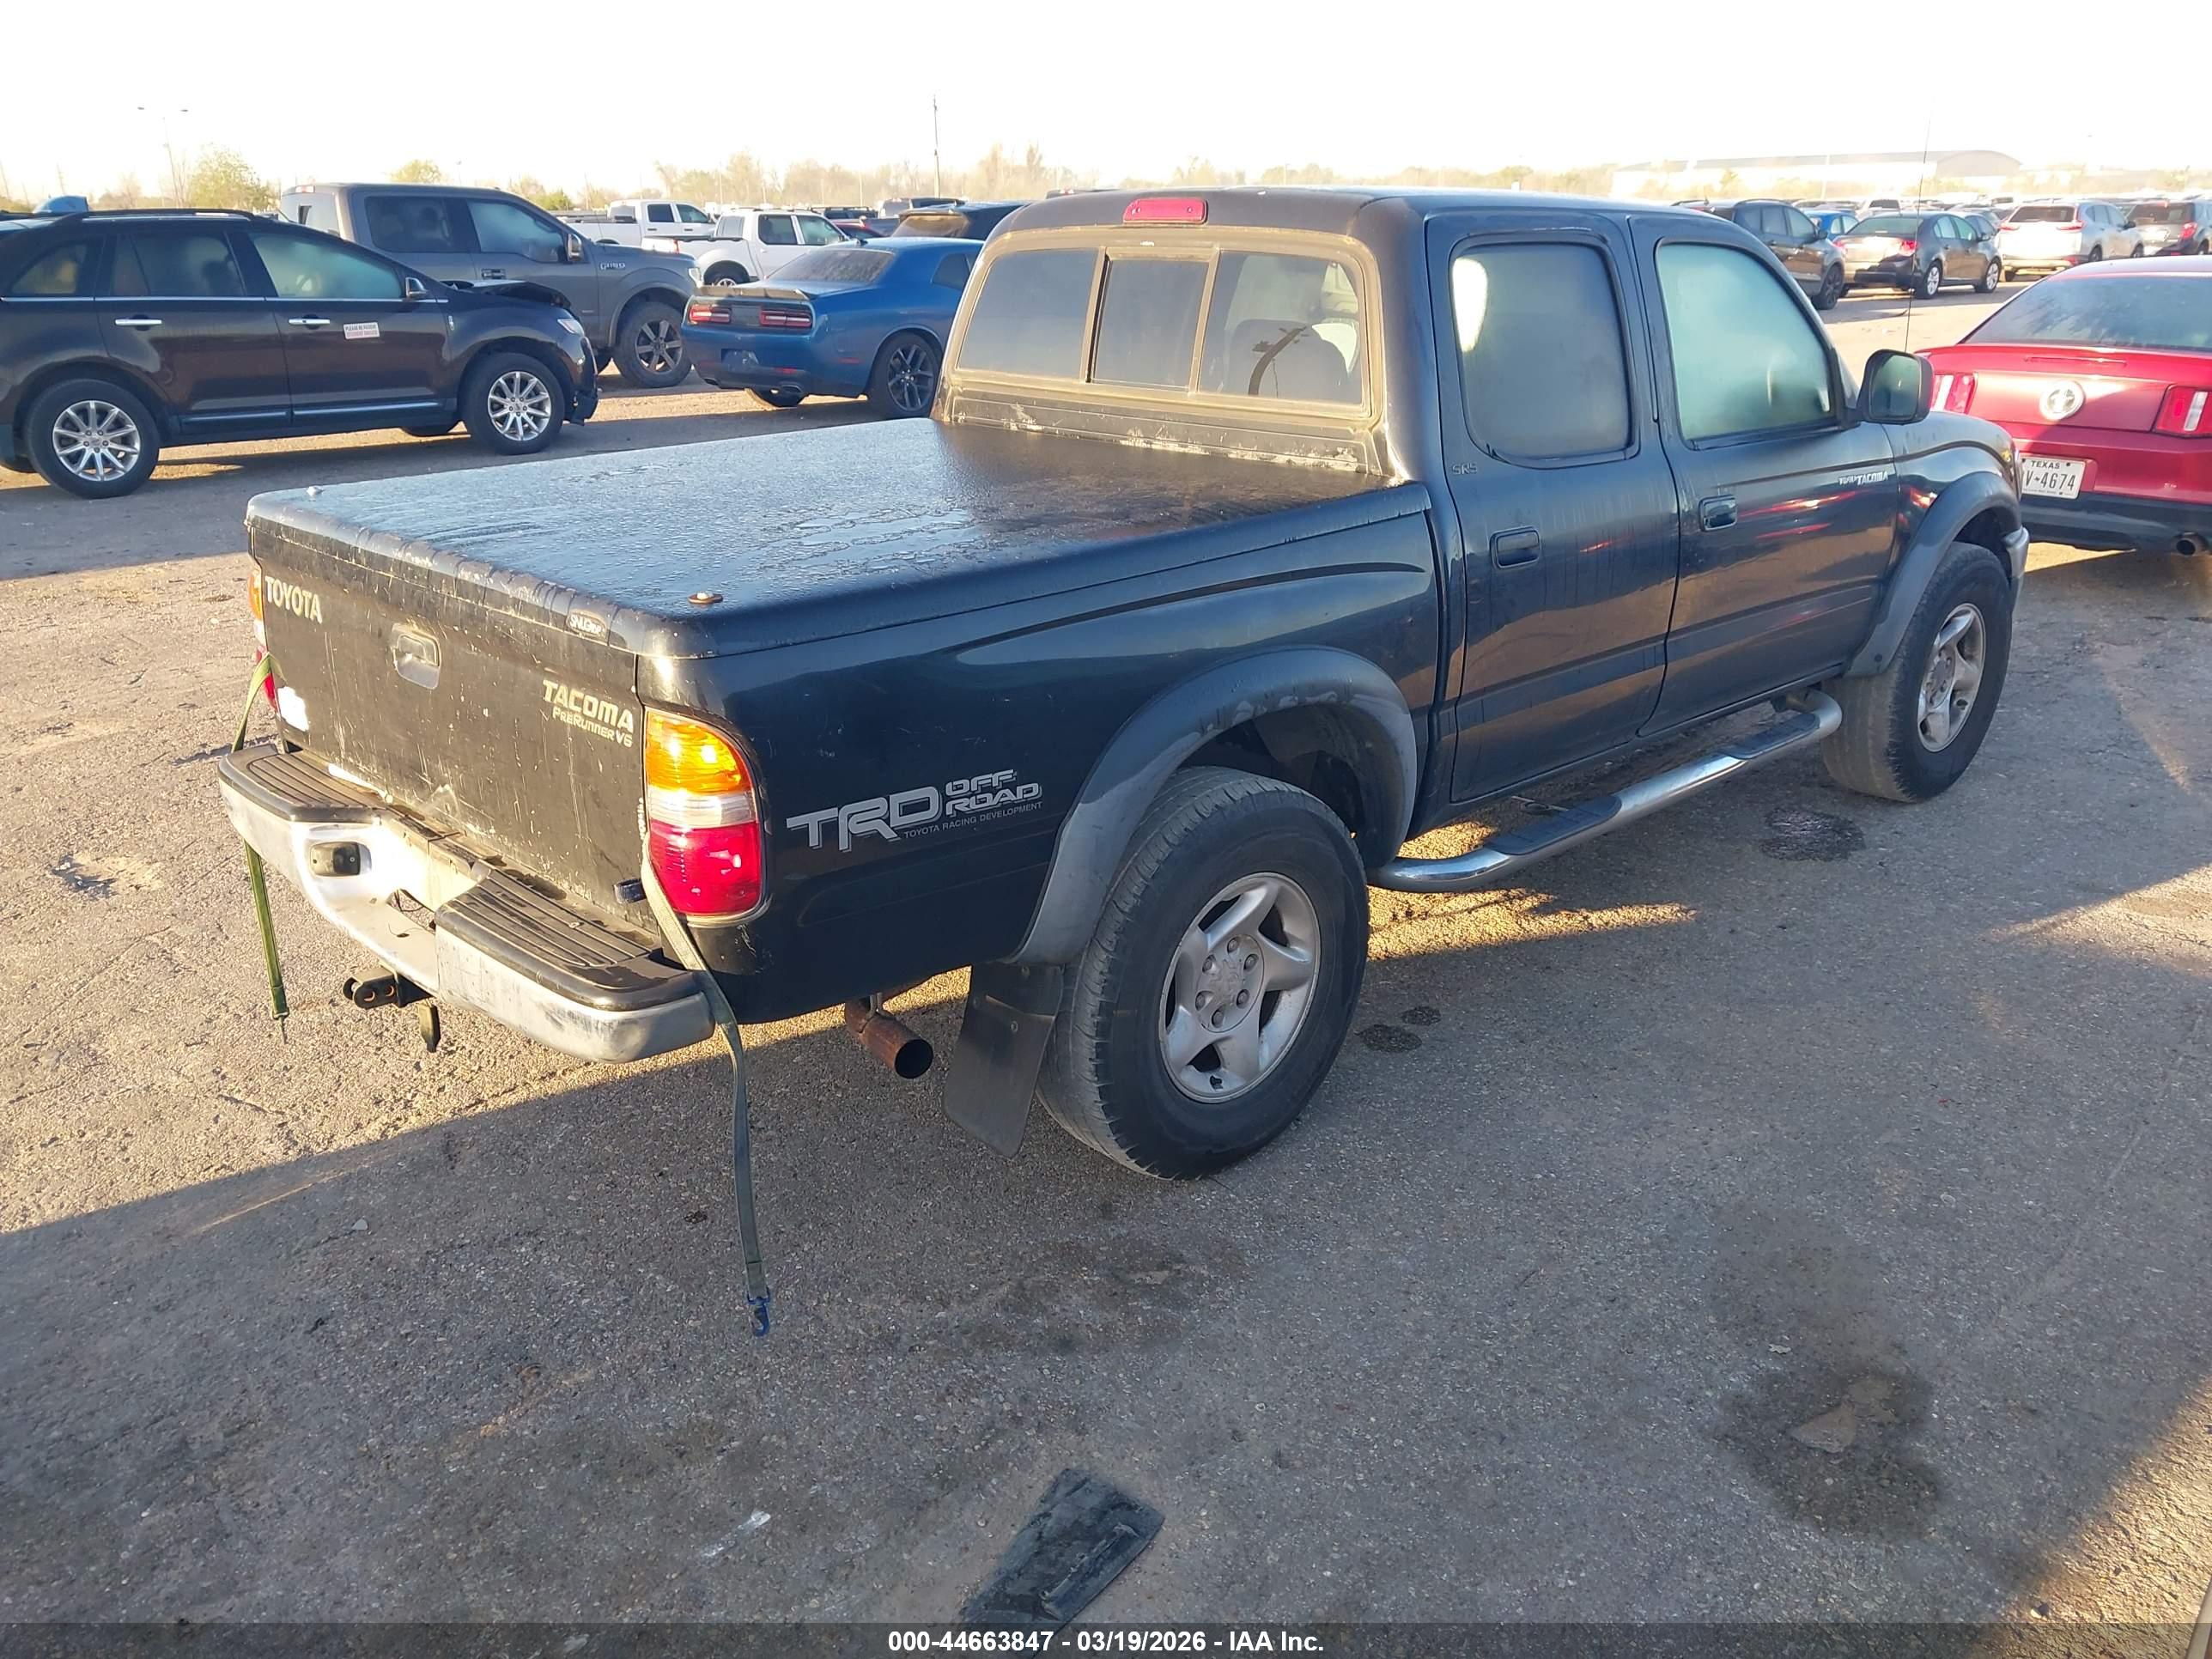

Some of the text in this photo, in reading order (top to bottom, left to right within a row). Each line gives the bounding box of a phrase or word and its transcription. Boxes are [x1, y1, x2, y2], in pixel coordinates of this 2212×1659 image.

[1857, 471, 1888, 485] TACOMA
[2031, 459, 2060, 470] TEXAS
[264, 575, 323, 624] TOYOTA
[543, 679, 635, 732] TACOMA
[615, 729, 634, 748] V6
[945, 769, 1017, 798] OFF
[945, 782, 1042, 817] ROAD
[786, 786, 943, 852] TRD
[904, 801, 1042, 839] TOYOTA RACING DEVELOPMENT
